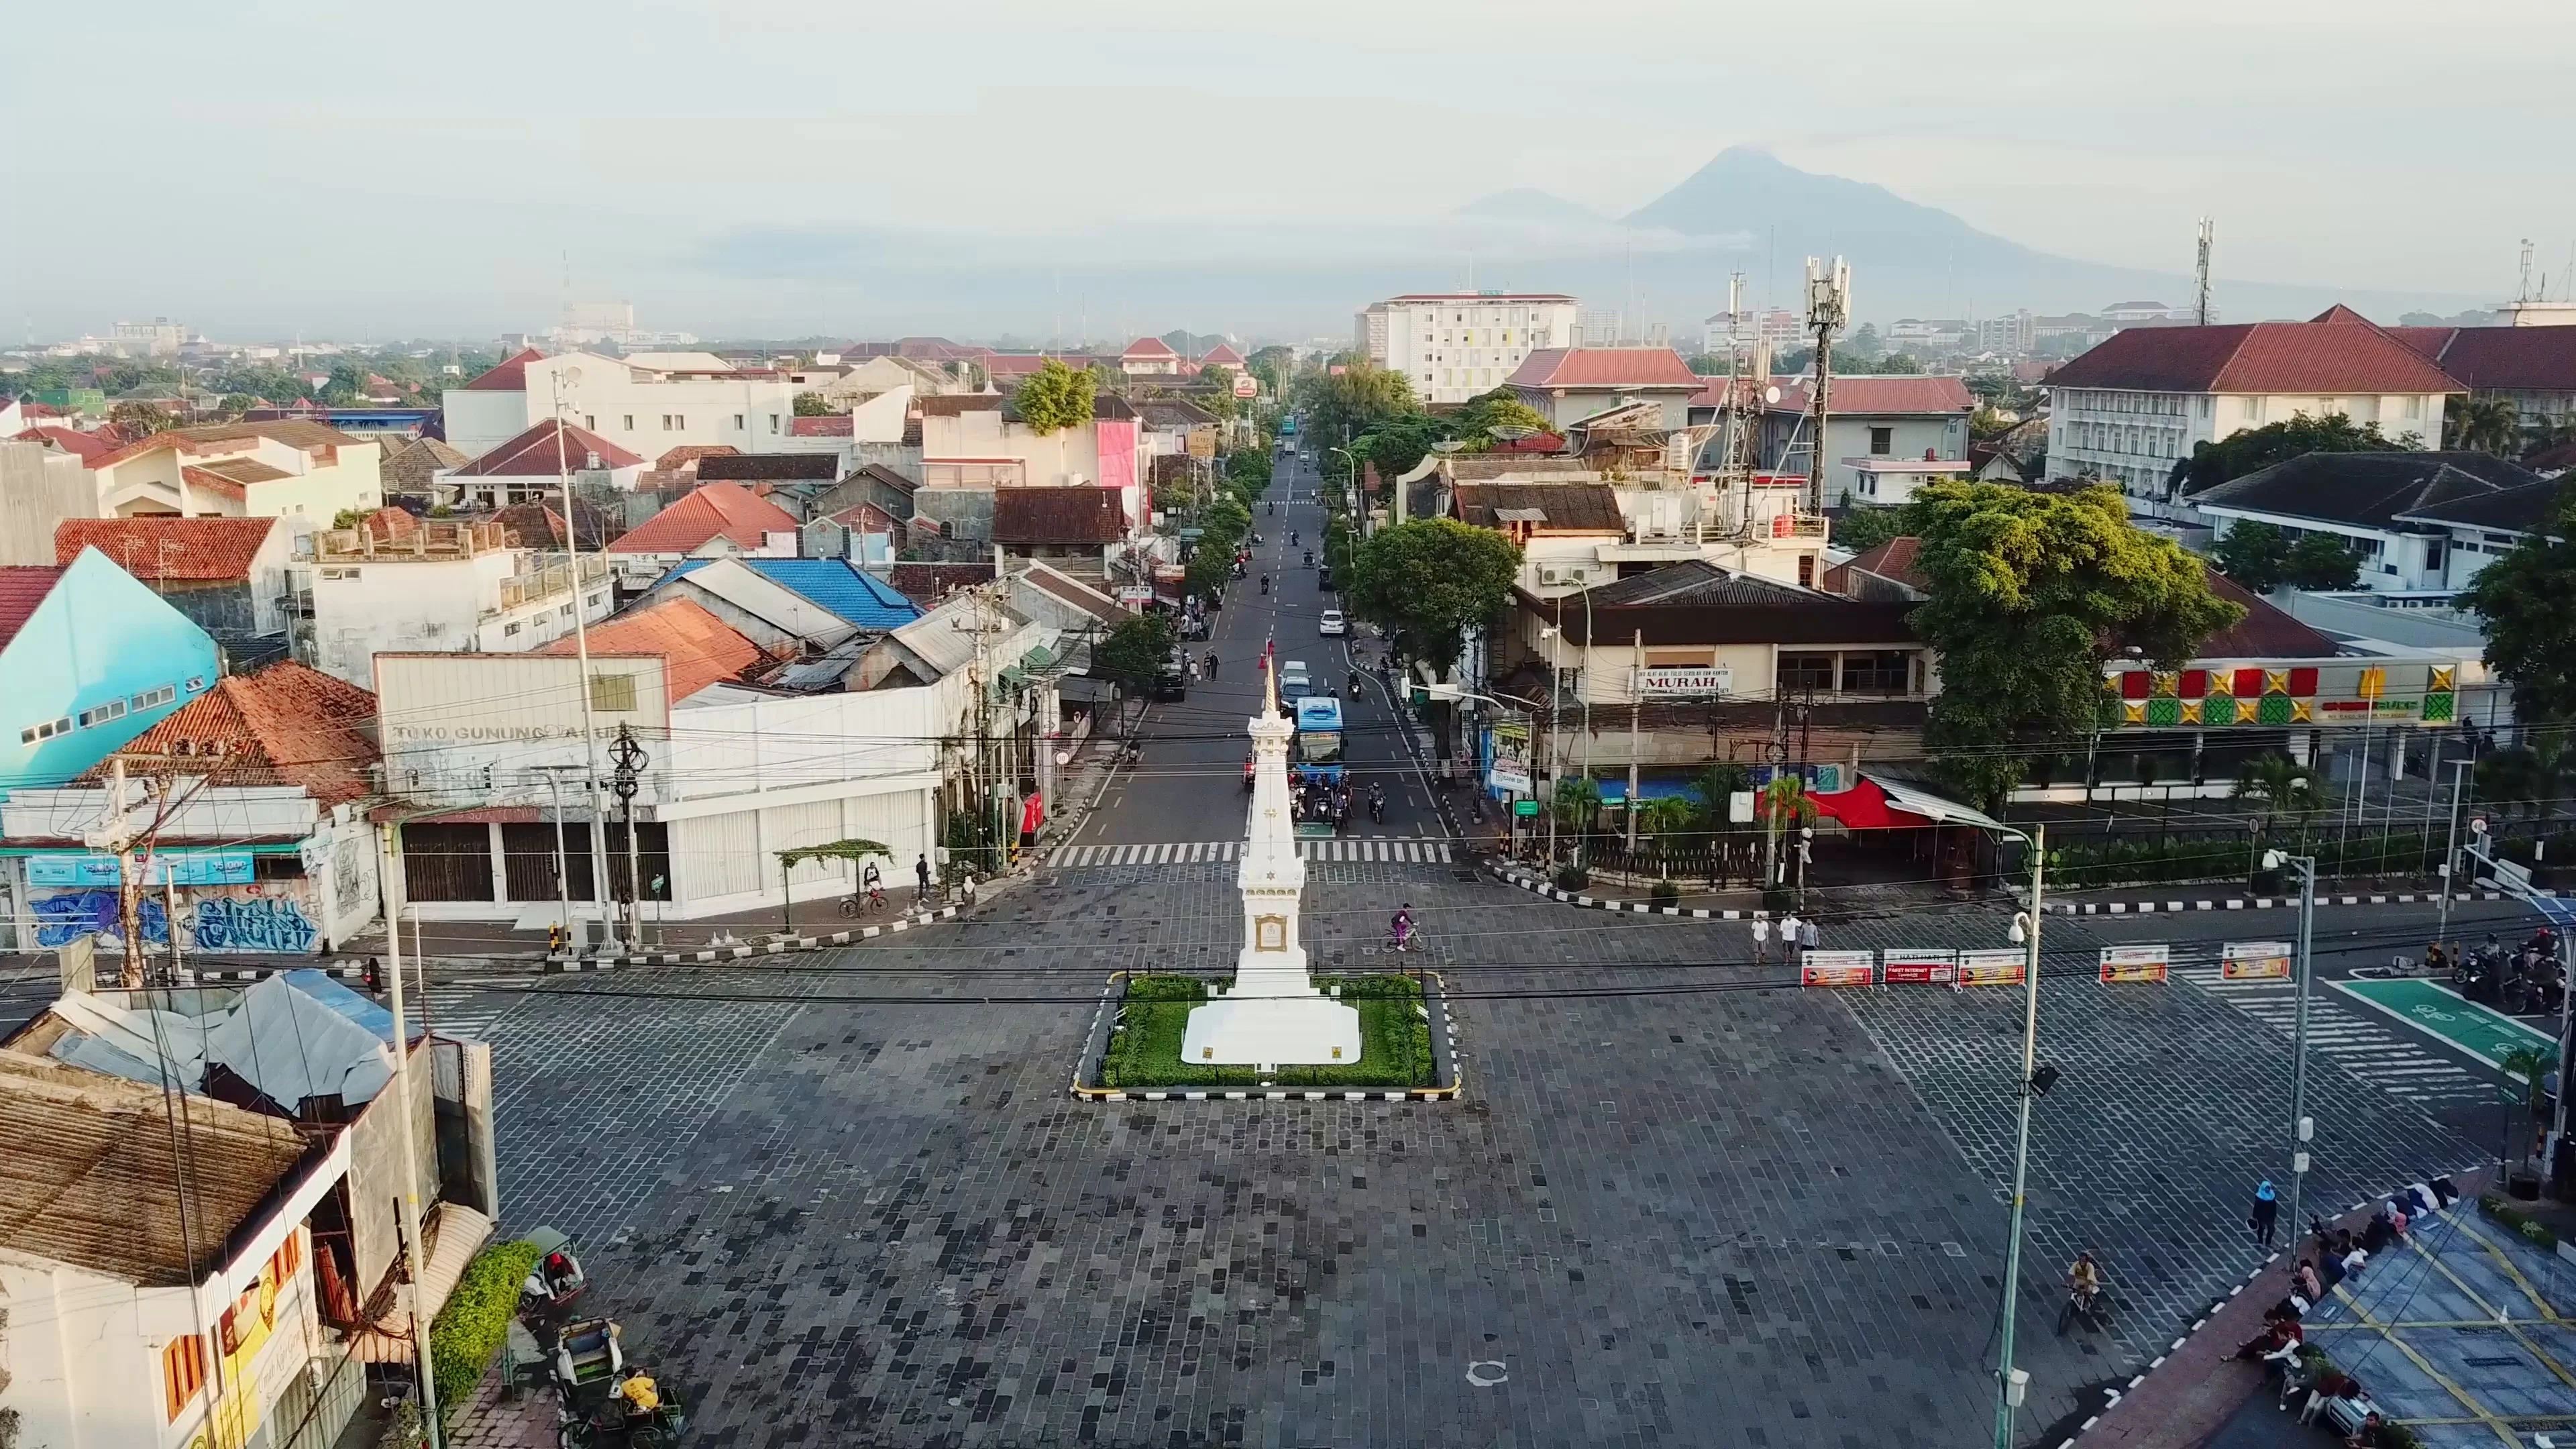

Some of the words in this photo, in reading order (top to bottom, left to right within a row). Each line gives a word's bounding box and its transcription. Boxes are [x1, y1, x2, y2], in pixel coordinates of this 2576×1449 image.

[1646, 677, 1716, 688] MURAH
[393, 727, 447, 739] TOKO
[455, 727, 545, 739] GUNUNG
